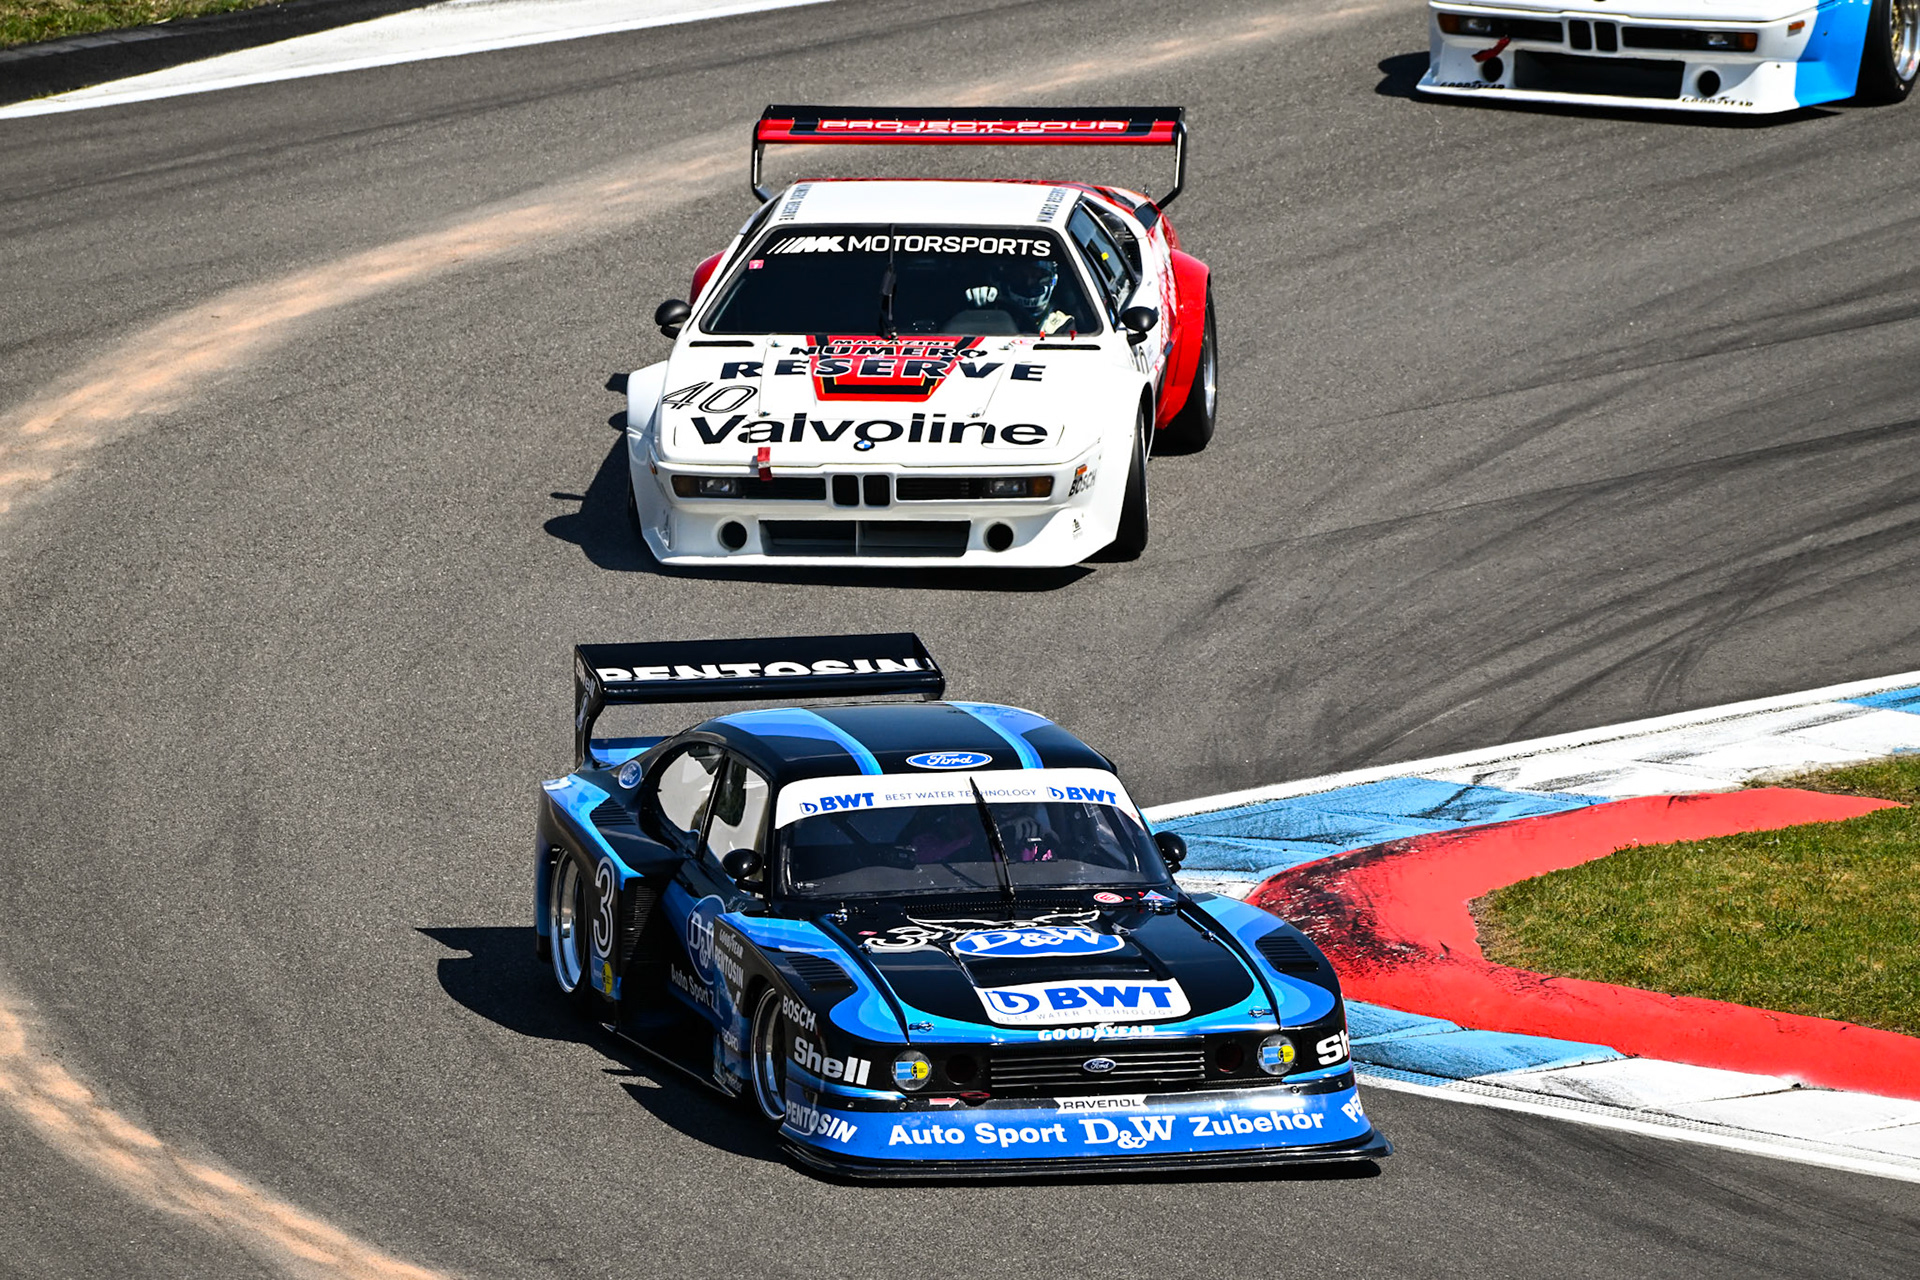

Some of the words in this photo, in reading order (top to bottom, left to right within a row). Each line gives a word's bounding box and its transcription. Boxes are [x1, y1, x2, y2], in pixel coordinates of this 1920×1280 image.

[821, 120, 1003, 129] PROJECT
[1016, 121, 1125, 130] FOUR
[847, 235, 1051, 257] MOTORSPORTS
[789, 345, 988, 359] NUMERO
[829, 339, 956, 347] MAGAZINE
[662, 381, 758, 414] 40
[690, 412, 1049, 447] Valvoline
[926, 753, 973, 766] Ford
[819, 792, 875, 812] BWT
[884, 792, 914, 802] BEST
[915, 791, 955, 800] WATER
[1065, 786, 1117, 805] BWT
[593, 856, 616, 959] 3
[970, 927, 1104, 953] D&W
[1044, 986, 1173, 1011] BWT
[781, 995, 817, 1032] BOSCH
[1037, 1010, 1080, 1020] WATER
[1087, 1008, 1175, 1017] TECHNOLOGY
[1037, 1022, 1156, 1042] GOODYEAR
[794, 1036, 872, 1086] Shell
[1062, 1097, 1142, 1110] RAVENOL
[785, 1099, 858, 1144] PENTOSIN
[888, 1124, 965, 1145] Auto
[975, 1122, 1067, 1148] Sport
[1079, 1115, 1176, 1149] D&W
[1188, 1108, 1325, 1137] Zubehör
